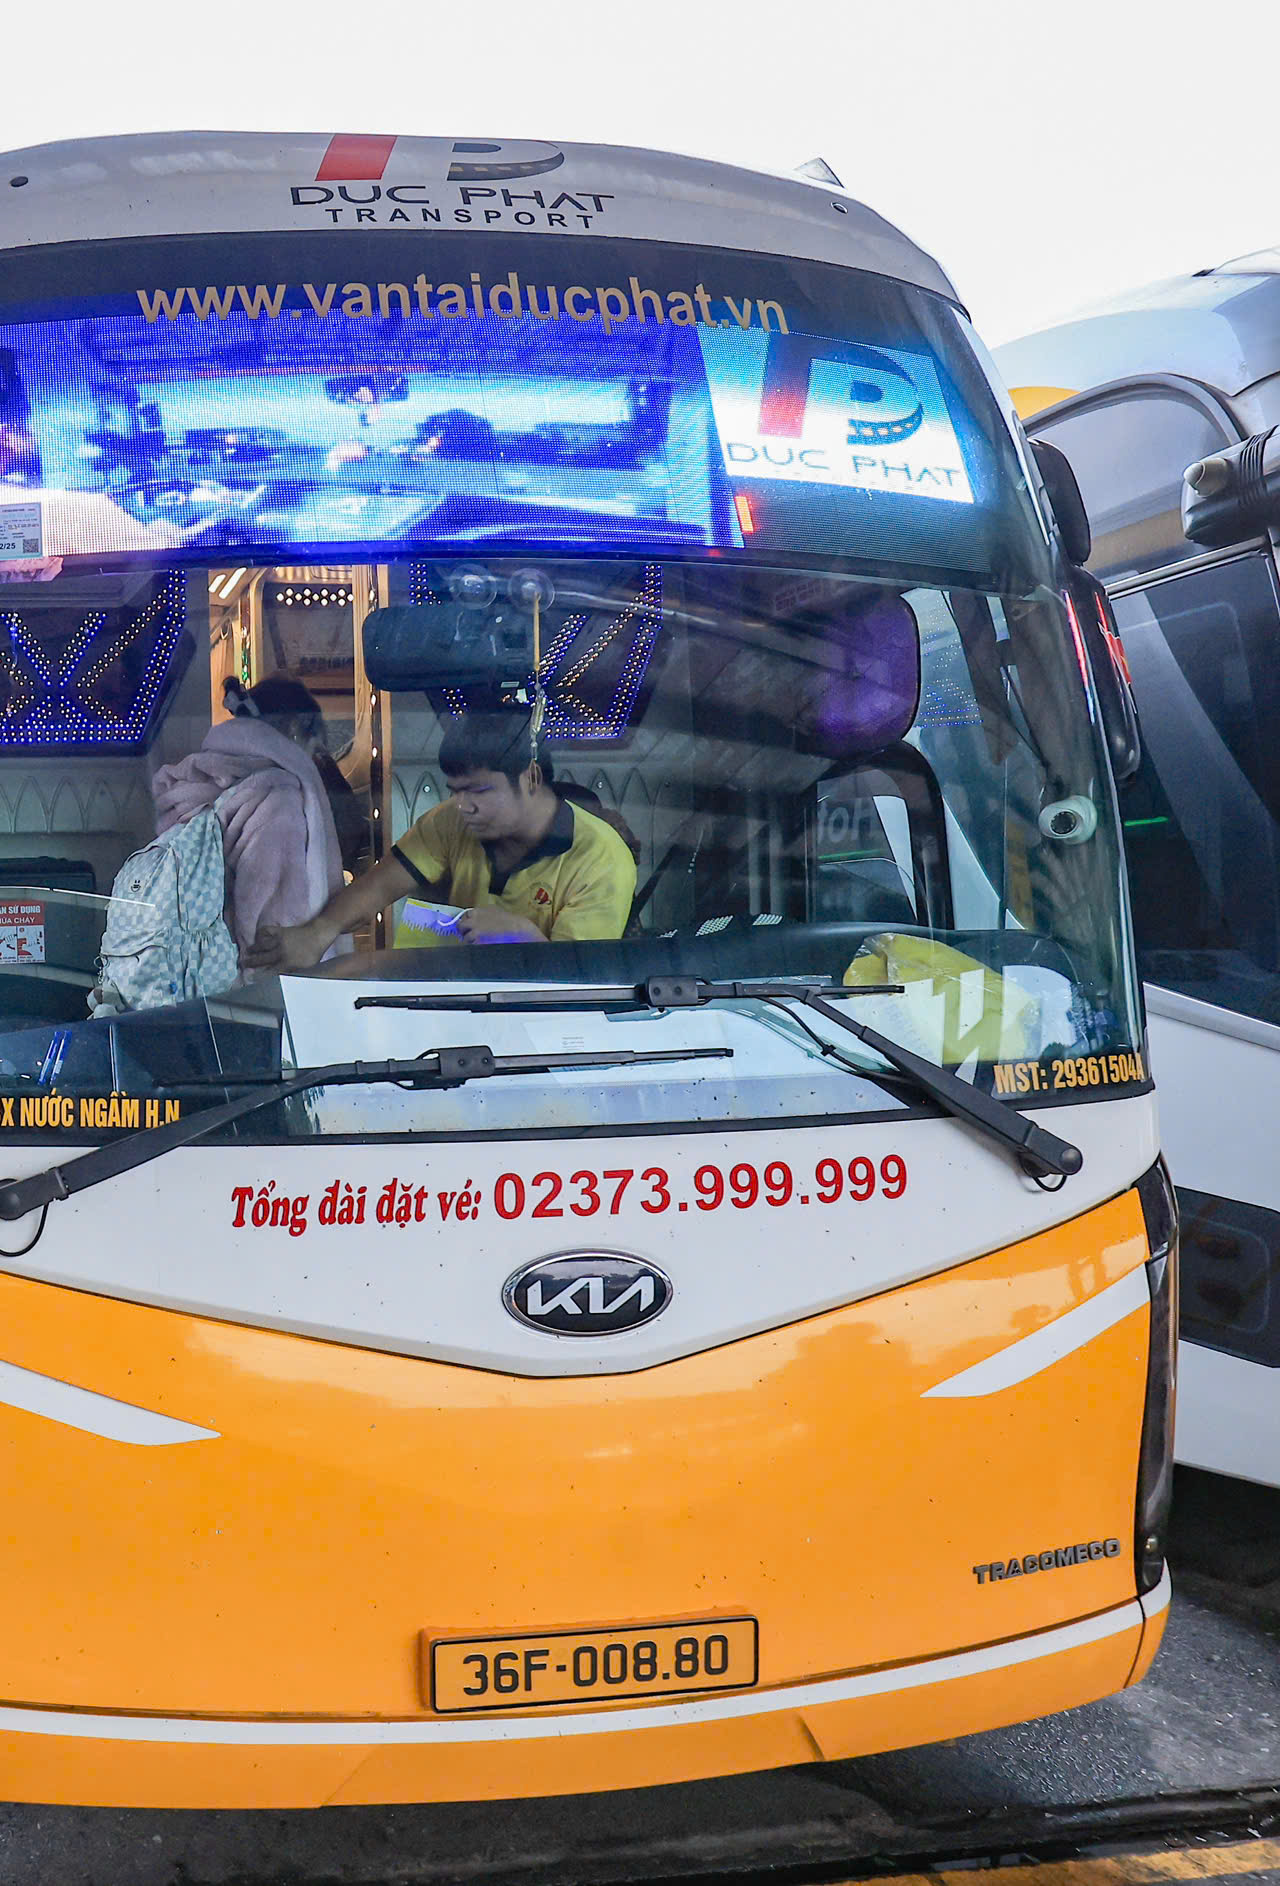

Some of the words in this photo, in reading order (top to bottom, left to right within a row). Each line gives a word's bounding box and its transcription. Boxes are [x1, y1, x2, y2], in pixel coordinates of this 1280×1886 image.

[289, 185, 430, 206] DUC
[459, 186, 615, 212] PHAT
[325, 208, 593, 229] TRANSPORT
[136, 271, 789, 335] www.vantaiducphat.vn
[726, 442, 830, 470] DUC
[852, 455, 962, 487] PHAT
[993, 1061, 1048, 1094] MST:
[20, 1088, 74, 1128] NƯỚC
[80, 1090, 140, 1129] NGẦM
[145, 1099, 180, 1128] H.N
[231, 1179, 309, 1237] Tổng
[318, 1179, 368, 1225] đài
[376, 1177, 428, 1229] đặt
[437, 1179, 482, 1222] vé:
[493, 1154, 908, 1219] 02373.999.999
[526, 1275, 655, 1316] KIA
[972, 1538, 1121, 1585] TRACOMECO
[462, 1634, 729, 1696] 36F-008.80
